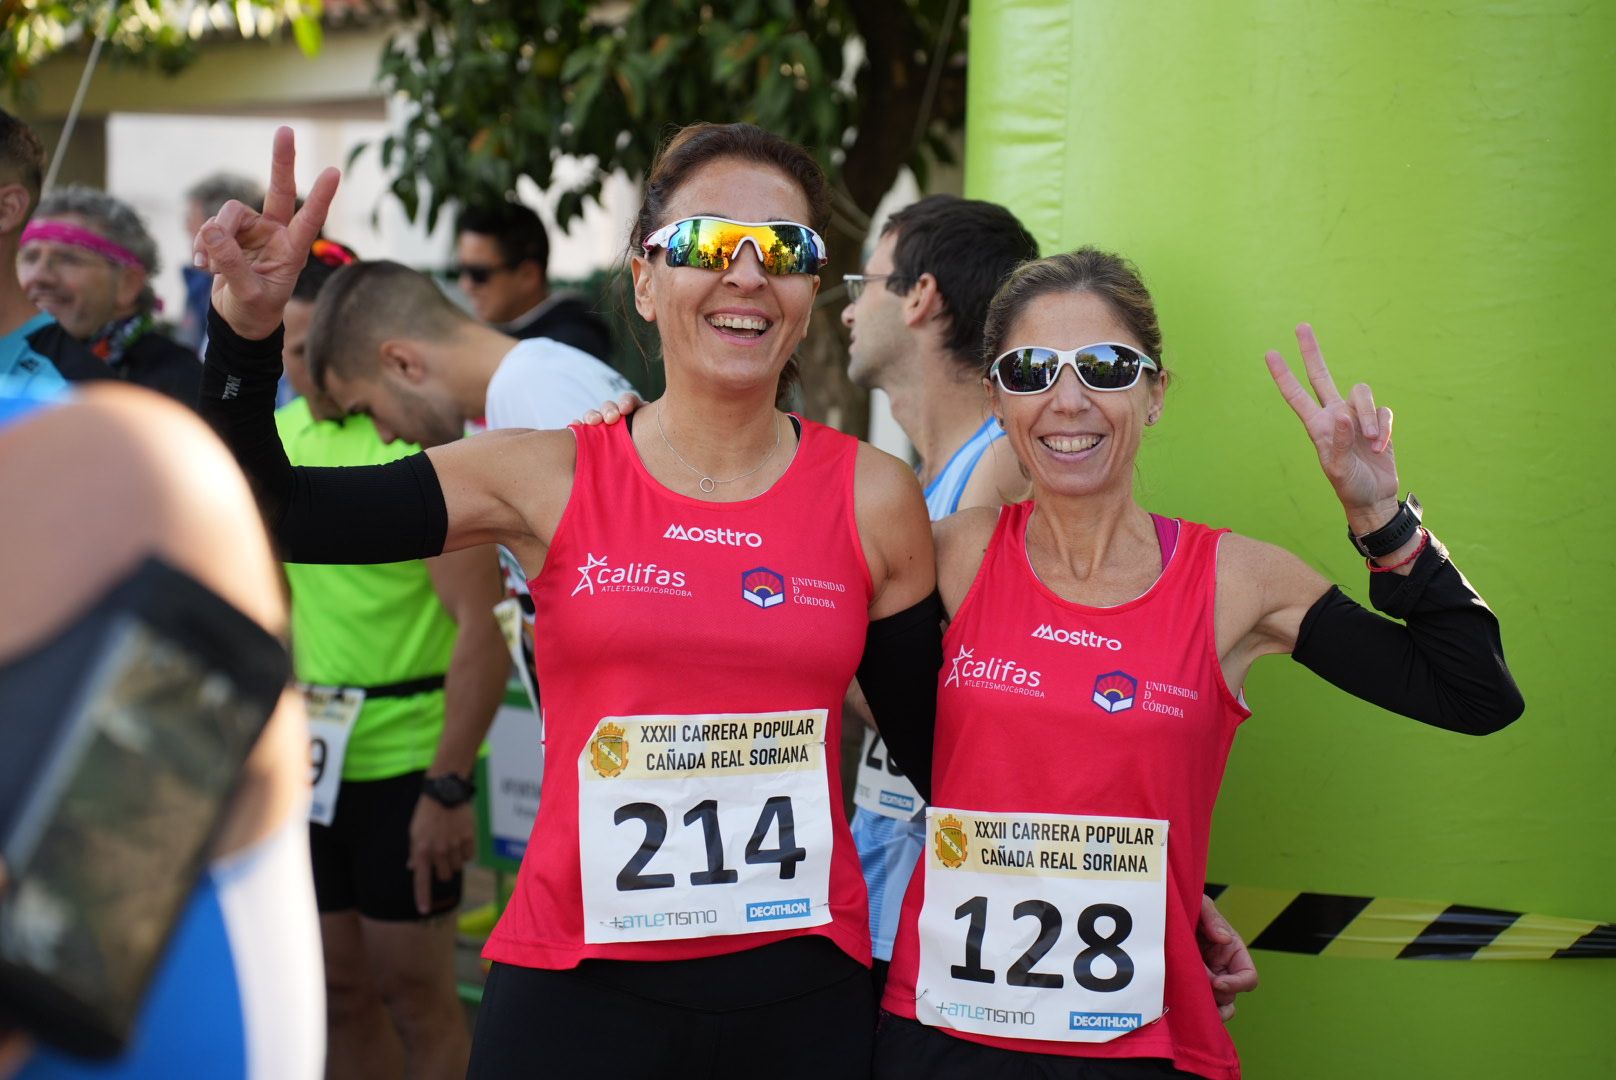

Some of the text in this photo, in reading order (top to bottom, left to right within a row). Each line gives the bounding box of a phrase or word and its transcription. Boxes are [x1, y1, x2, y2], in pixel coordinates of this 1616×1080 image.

[597, 564, 686, 588] califas
[791, 576, 846, 593] UNIVERSIDAD
[793, 594, 836, 609] CÓRDOBA
[961, 658, 1041, 687] califas
[1145, 680, 1198, 701] UNIVERSIDAD
[1142, 700, 1184, 719] CÓRDOBA
[640, 718, 815, 743] XXXII CARRERA POPULAR
[646, 745, 809, 771] CAÑADA REAL SORIANA
[613, 796, 806, 892] 214
[974, 820, 1154, 846] XXXII CARRERA POPULAR
[981, 845, 1035, 869] CAÑADA
[1040, 851, 1077, 870] REAL
[1082, 853, 1148, 873] SORIANA
[749, 903, 808, 919] DECATHLON
[950, 895, 1135, 993] 128
[1073, 1014, 1138, 1029] DECATHLON
